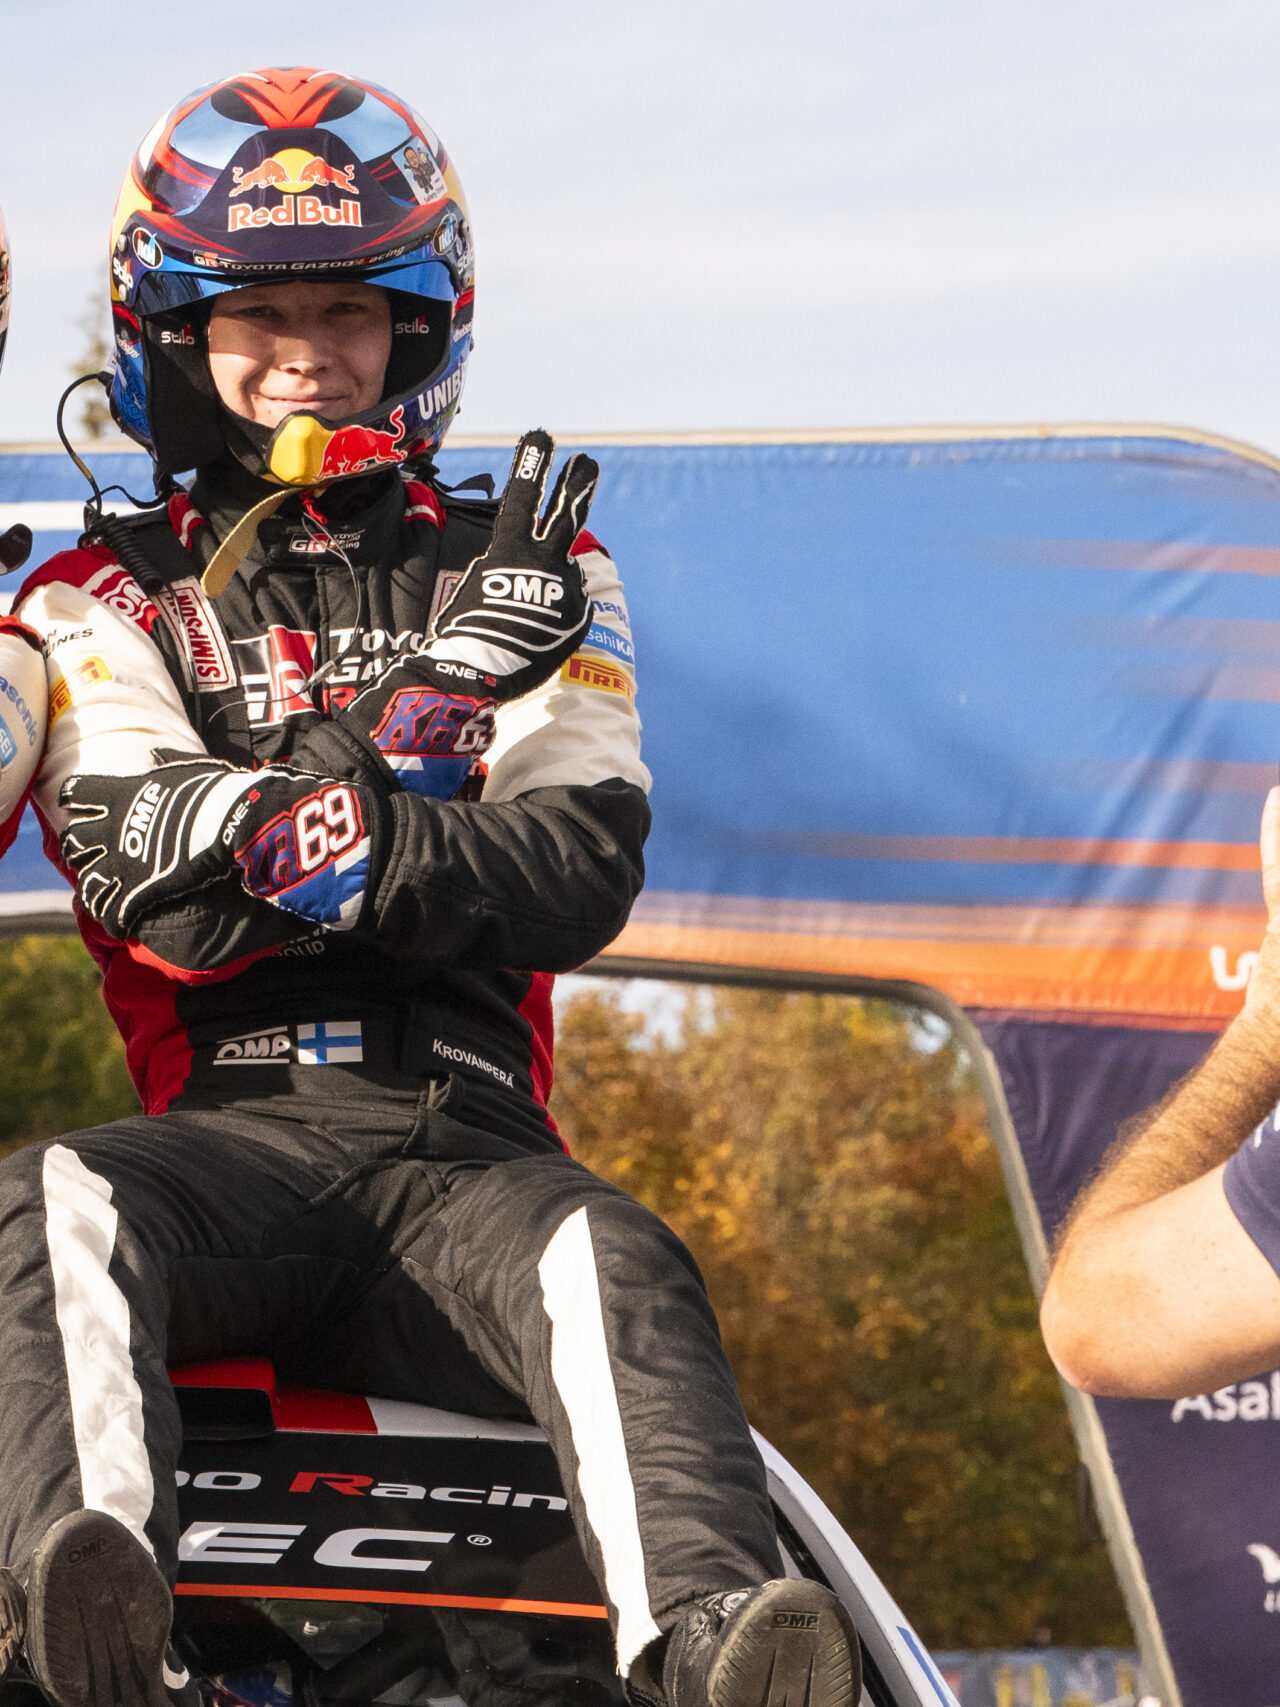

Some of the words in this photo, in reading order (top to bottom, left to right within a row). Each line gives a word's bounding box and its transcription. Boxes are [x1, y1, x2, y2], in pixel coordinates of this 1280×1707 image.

[228, 194, 295, 232] Red
[297, 195, 363, 227] Bull
[221, 261, 286, 271] TOYOTA
[417, 366, 464, 421] UNIB
[519, 445, 541, 481] OMP
[481, 574, 564, 607] OMP
[166, 592, 221, 679] SIMPSON
[124, 781, 162, 858] OMP
[216, 1034, 292, 1059] OMP
[288, 1471, 569, 1511] Racin
[772, 1611, 820, 1631] OMP
